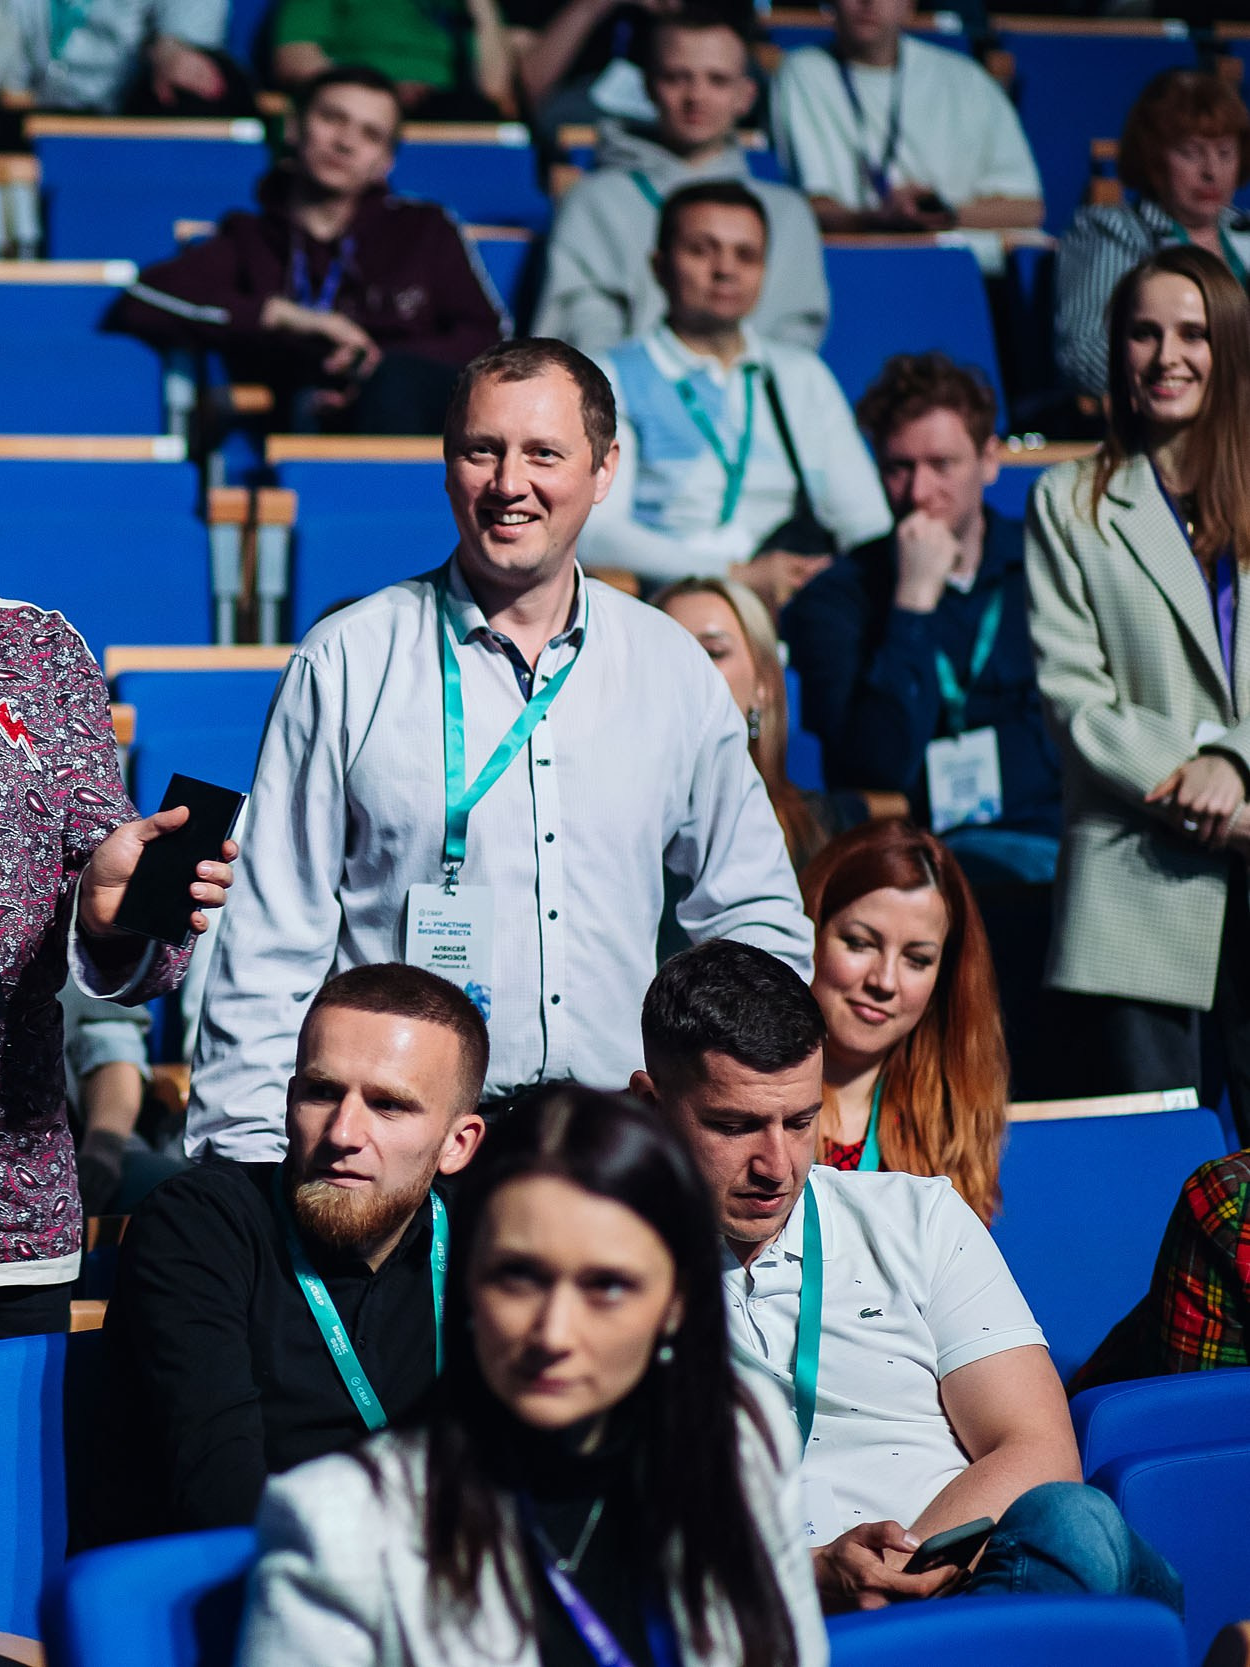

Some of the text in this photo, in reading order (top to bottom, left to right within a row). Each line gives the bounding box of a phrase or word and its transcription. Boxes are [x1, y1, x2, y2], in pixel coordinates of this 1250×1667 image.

[437, 1241, 446, 1262] СБЕР
[310, 1285, 325, 1307] СБЕР
[330, 1337, 343, 1356] ФЕСТ
[331, 1325, 349, 1354] БИЗНЕС
[356, 1386, 372, 1407] СБЕР
